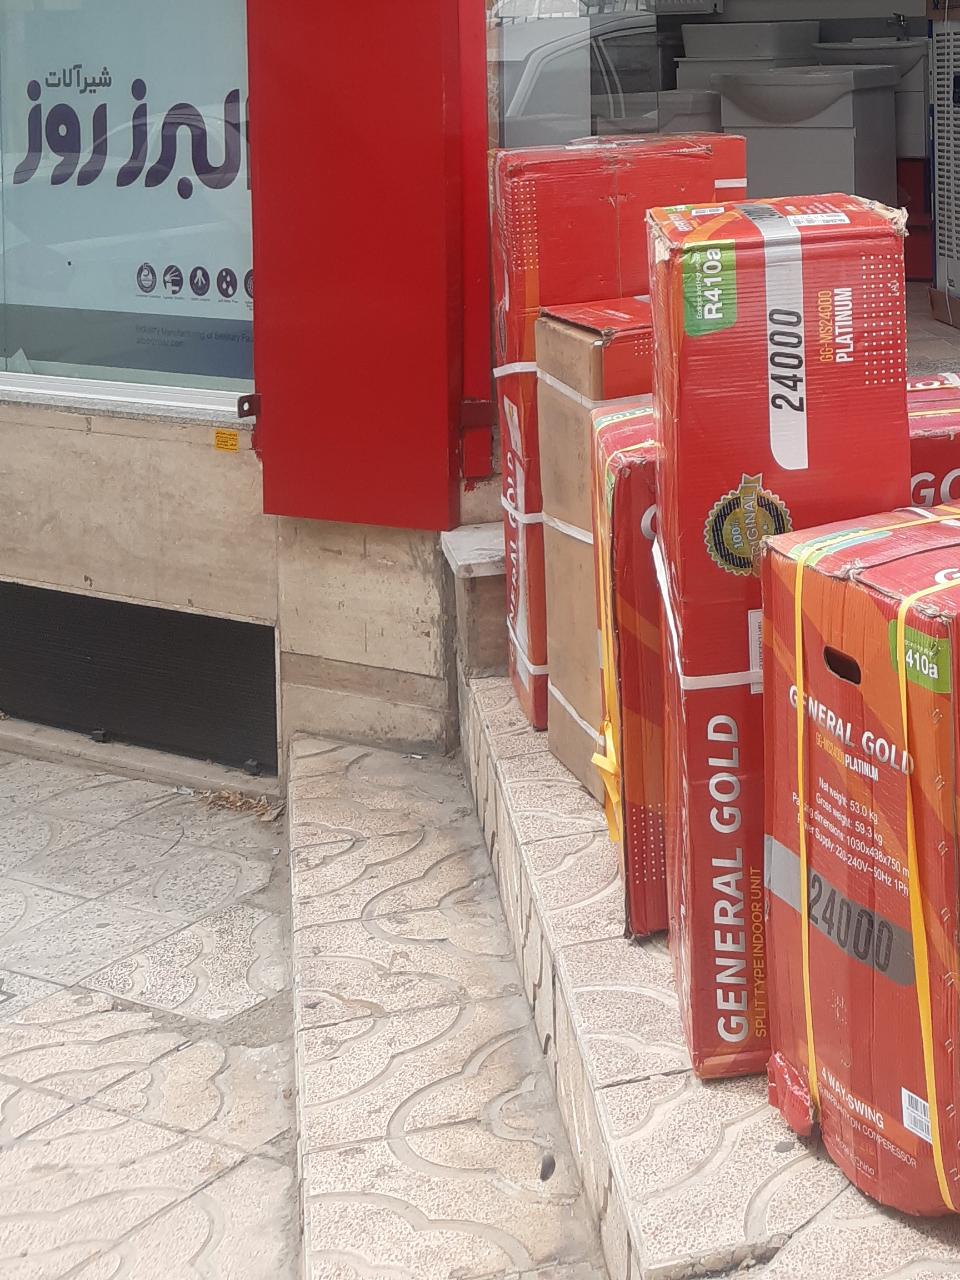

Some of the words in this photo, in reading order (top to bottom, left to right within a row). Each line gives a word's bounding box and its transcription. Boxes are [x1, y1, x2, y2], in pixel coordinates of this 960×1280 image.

[45, 64, 112, 94] شیرآلات
[13, 80, 107, 186] روز
[116, 78, 251, 200] لبرز
[703, 248, 724, 321] R410a
[768, 308, 804, 413] 24000
[817, 289, 834, 363] GG-MS24000
[834, 287, 853, 363] PLATINUM
[905, 649, 939, 679] 410a
[706, 714, 743, 834] GOLD
[862, 730, 915, 775] GOLD
[750, 866, 763, 900] UNIT
[708, 847, 750, 1042] GENERAL
[751, 902, 765, 957] INDOOR
[808, 873, 894, 972] 24000
[752, 959, 766, 998] TYPE
[753, 999, 767, 1038] SPLIT
[827, 1071, 884, 1129] WAY-SWING
